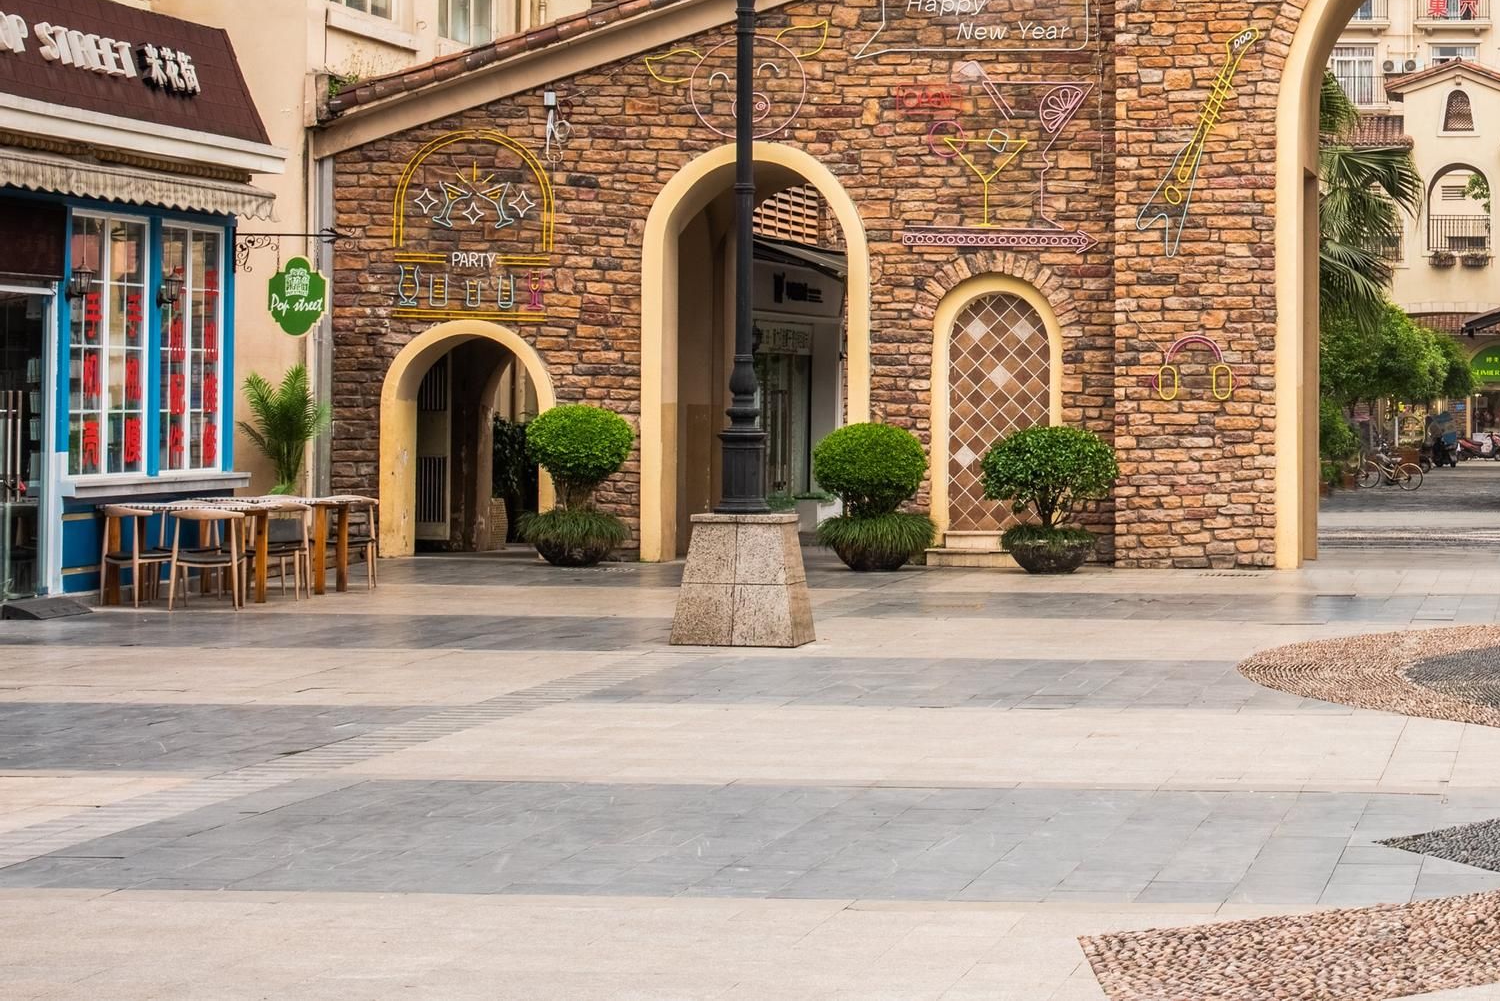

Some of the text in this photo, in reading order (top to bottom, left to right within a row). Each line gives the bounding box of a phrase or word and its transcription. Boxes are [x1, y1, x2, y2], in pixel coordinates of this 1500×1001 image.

[956, 21, 1070, 41] New Year
[34, 21, 138, 78] STREET
[451, 251, 497, 268] PARTY
[270, 293, 324, 317] Pop street
